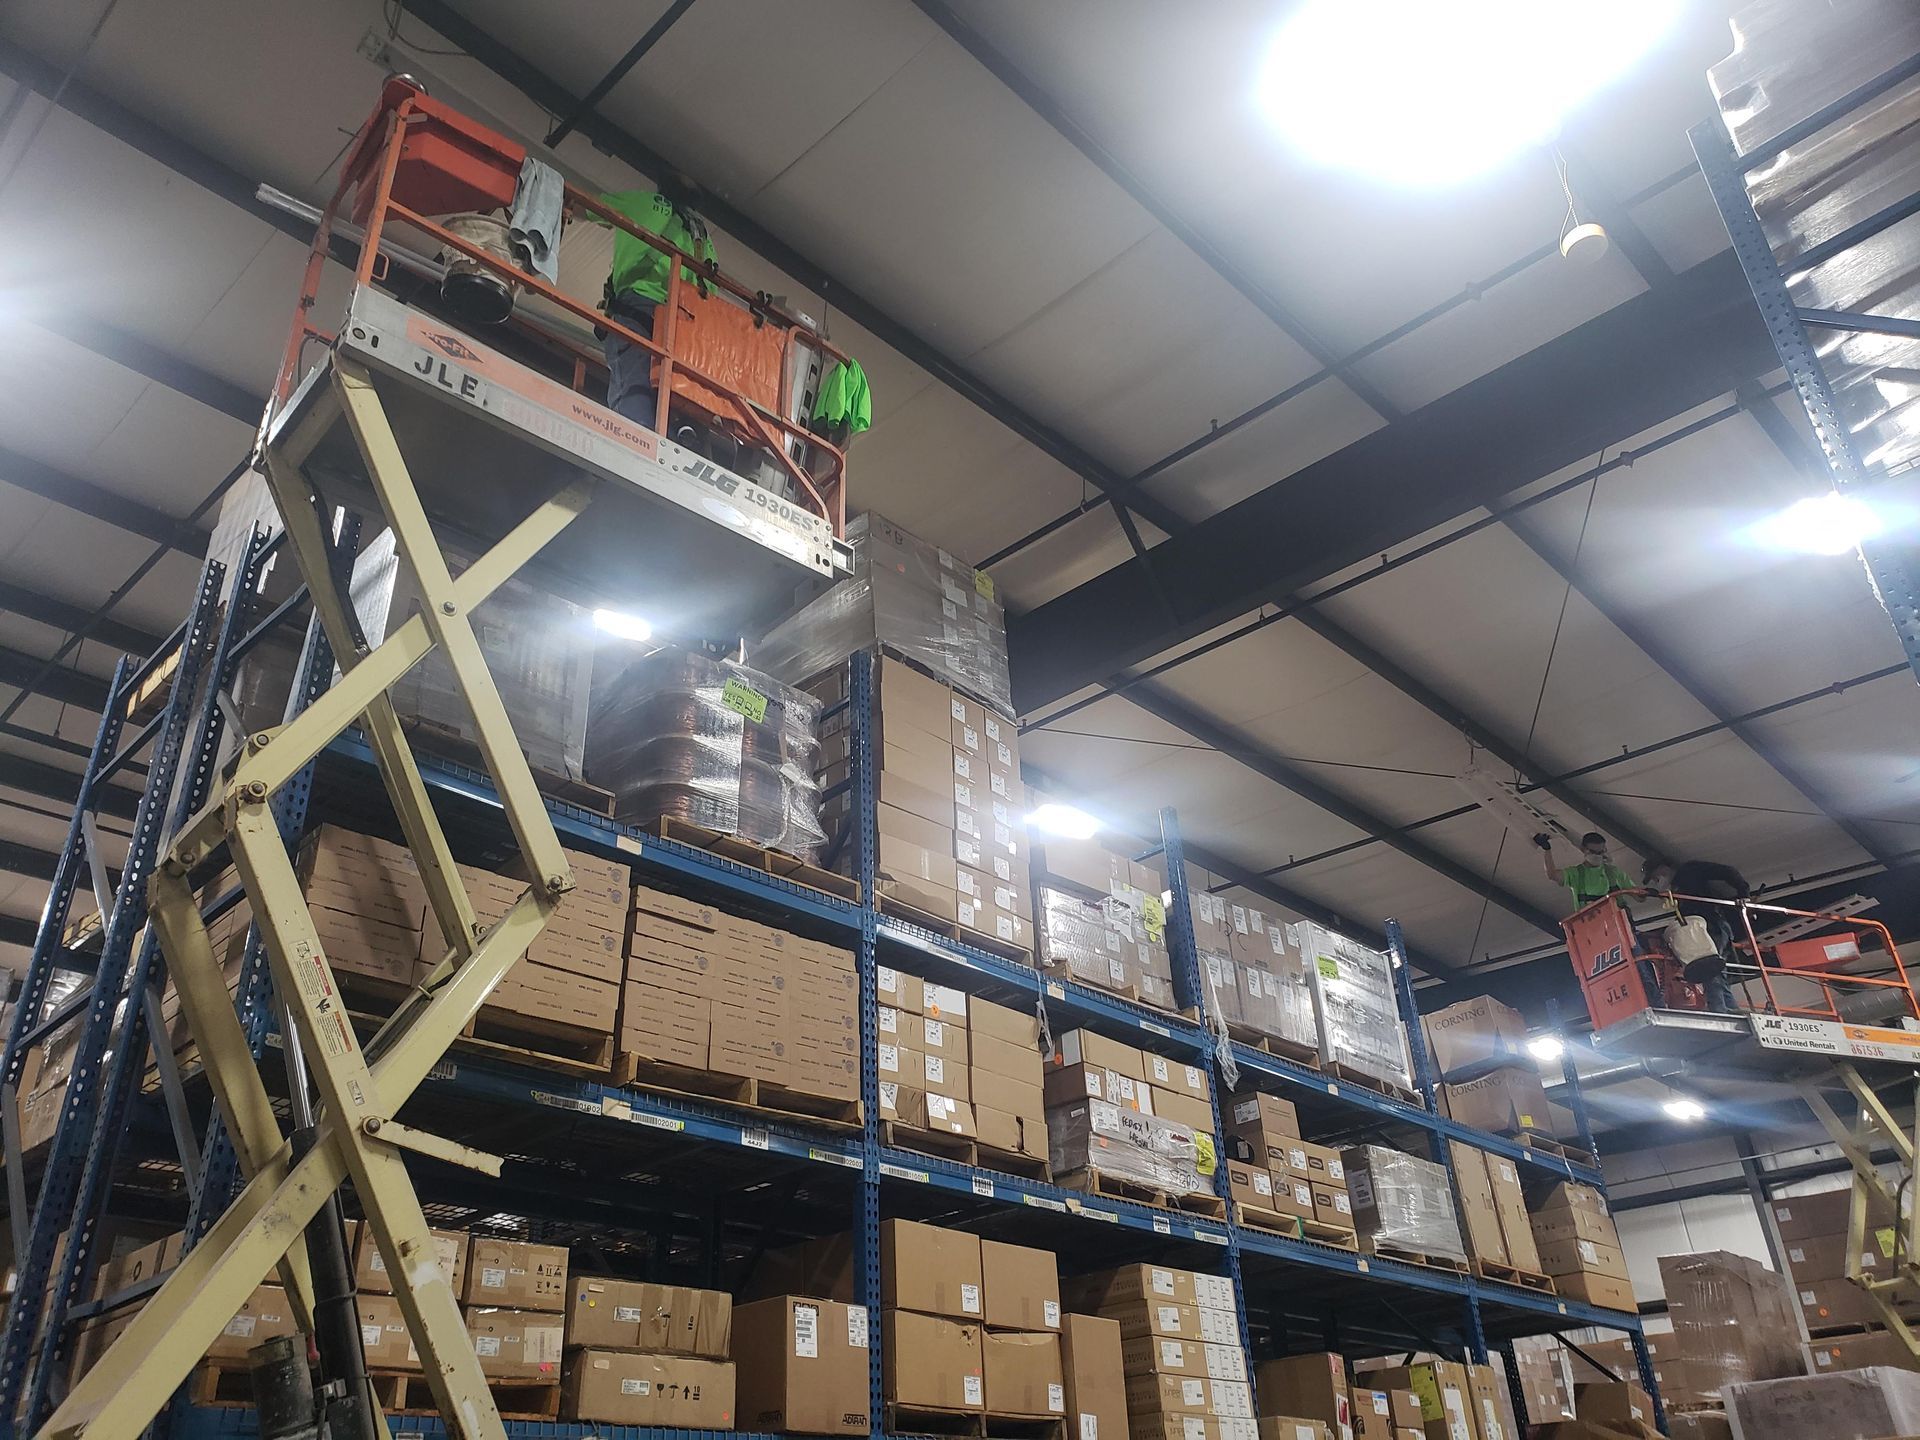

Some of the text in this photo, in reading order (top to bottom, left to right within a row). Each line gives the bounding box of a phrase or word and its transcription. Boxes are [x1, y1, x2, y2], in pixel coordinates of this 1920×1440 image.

[414, 355, 479, 399] JLE
[572, 404, 651, 450] www.jlg.com
[683, 459, 815, 532] JLG 1930ES
[1591, 944, 1622, 976] JLG
[1607, 984, 1629, 1004] JLE
[1435, 1007, 1486, 1031] CORNING
[1764, 1019, 1820, 1034] JLG 1930ES
[1783, 1038, 1836, 1051] United Rentals
[1450, 1077, 1502, 1098] CORNING
